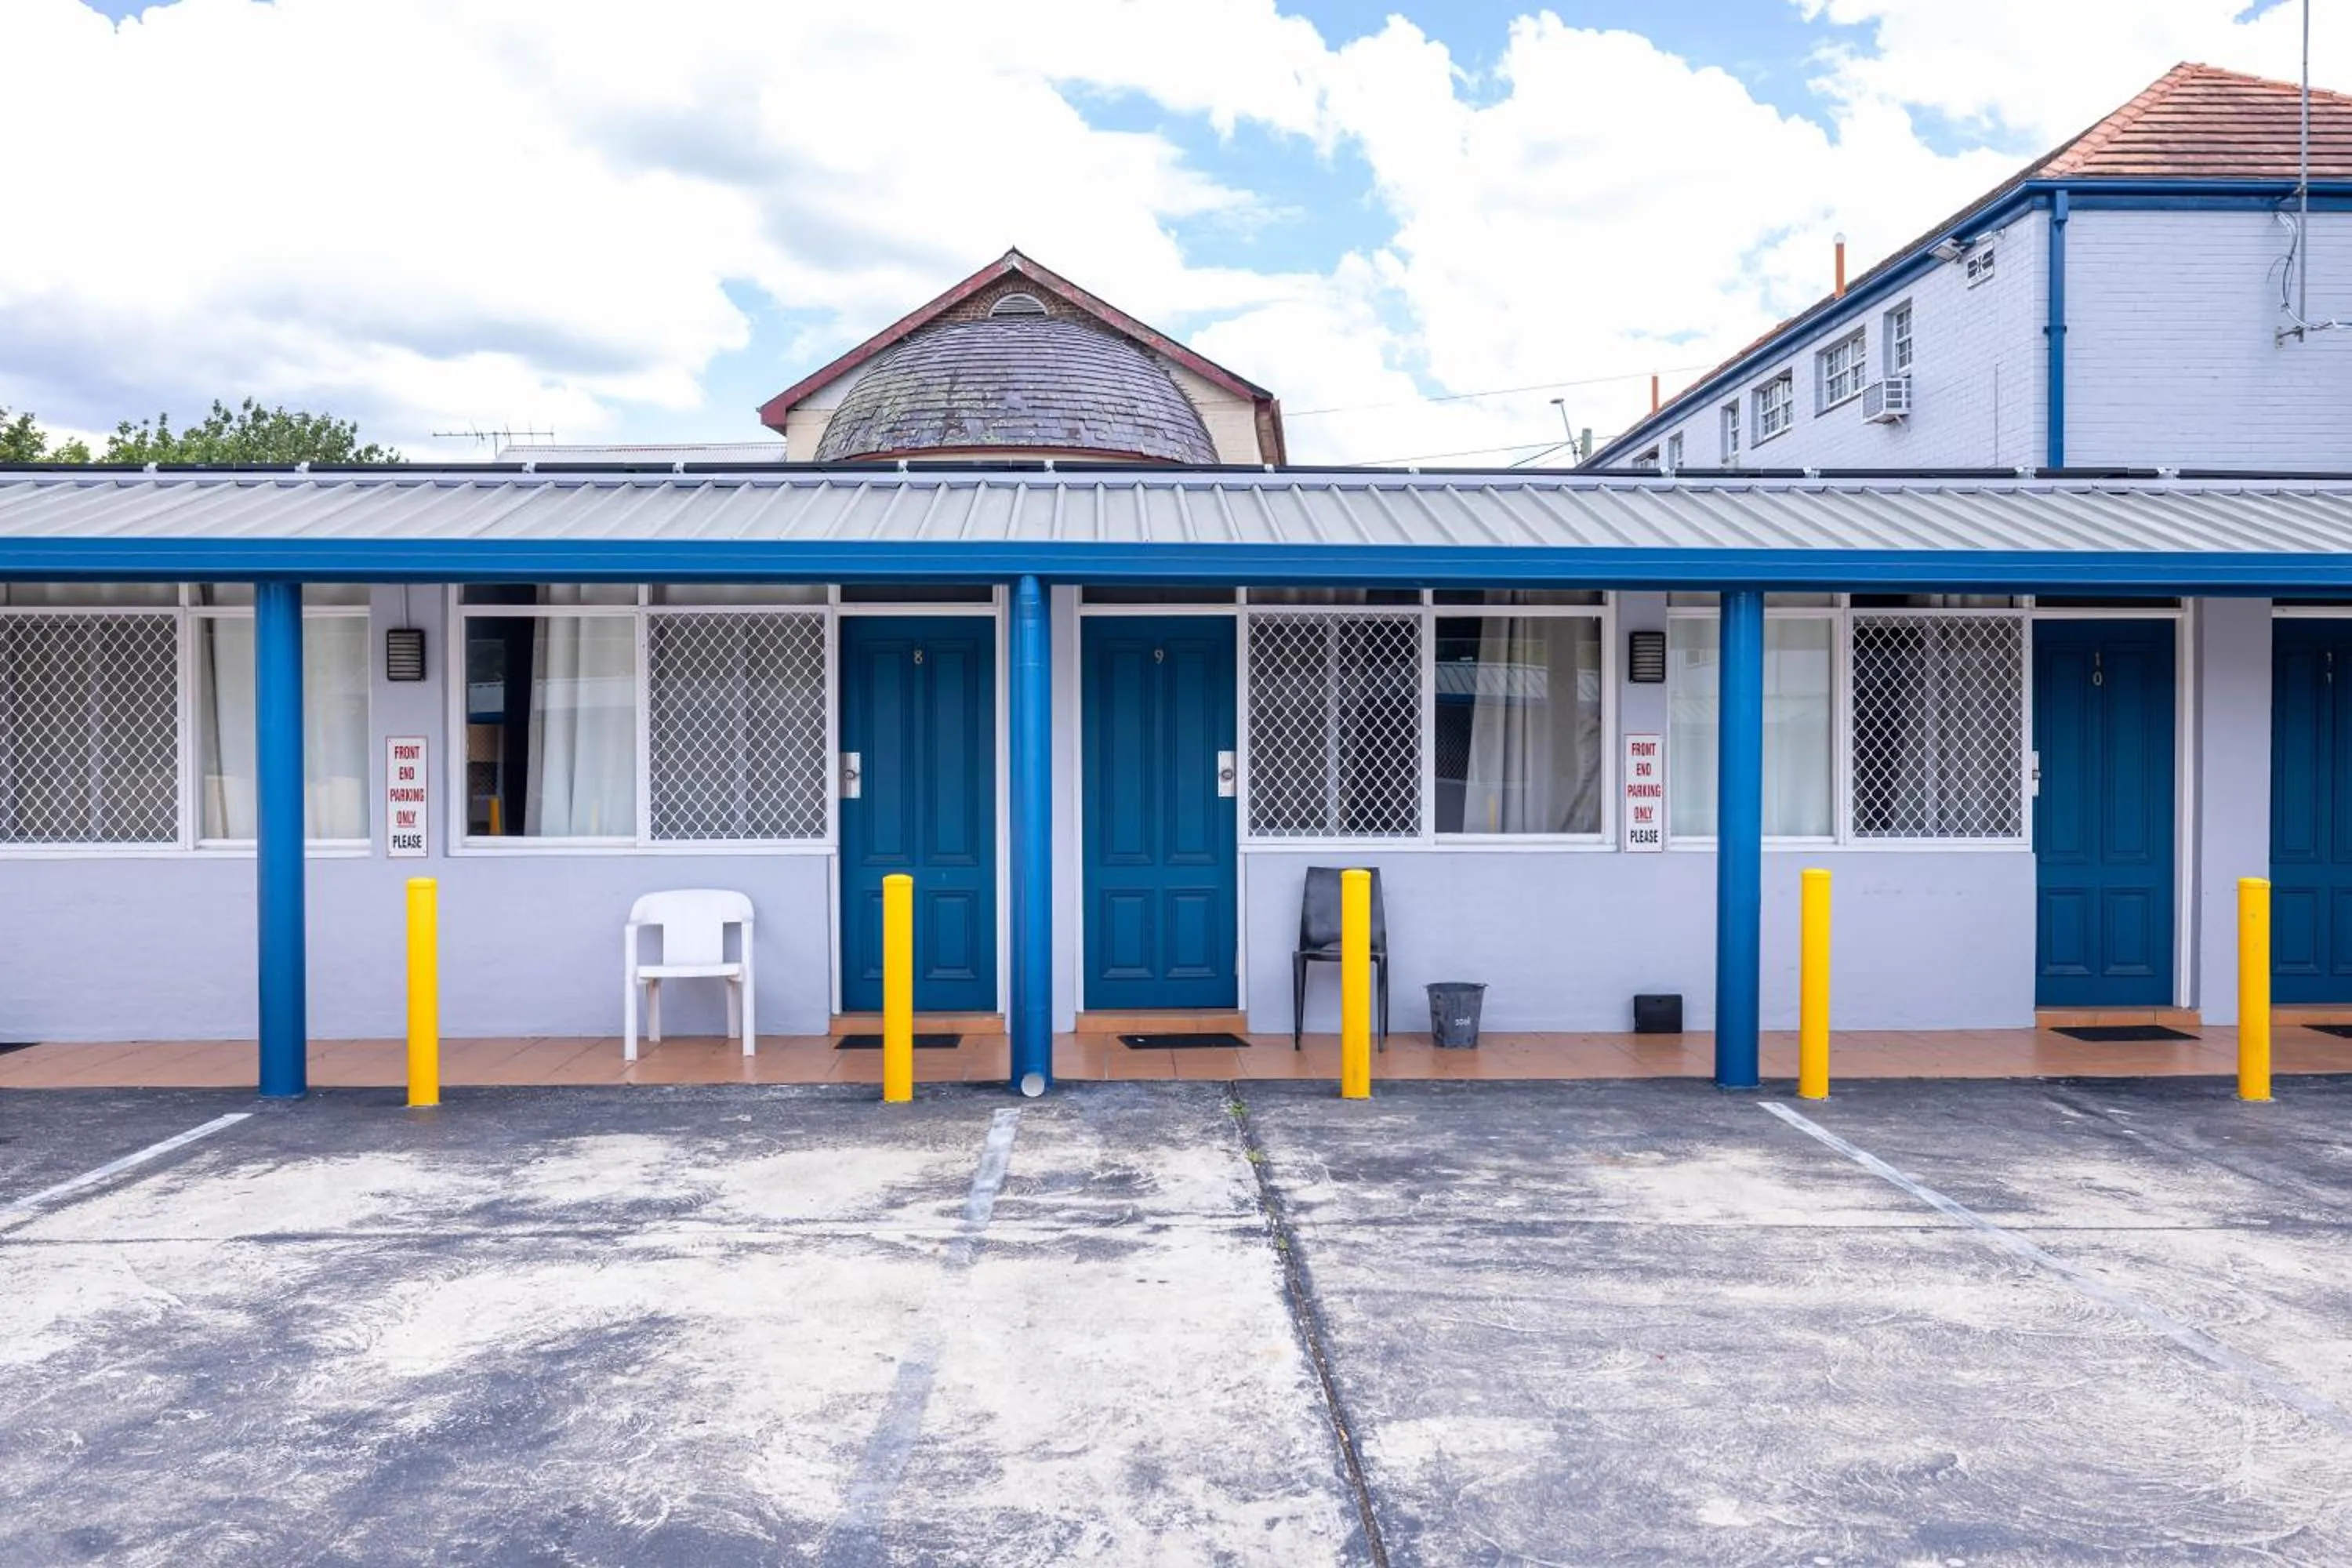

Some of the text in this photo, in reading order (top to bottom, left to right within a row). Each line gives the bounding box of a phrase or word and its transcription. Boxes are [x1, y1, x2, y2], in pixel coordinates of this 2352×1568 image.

[914, 650, 923, 664] 8
[1154, 649, 1164, 664] 9
[394, 746, 420, 759] FRONT
[1632, 742, 1656, 757] FRONT
[399, 766, 415, 780] END
[1636, 762, 1652, 776] END
[390, 788, 424, 801] PARKING
[1628, 784, 1661, 797] PARKING
[397, 810, 416, 824] ONLY
[1634, 806, 1653, 819] ONLY
[393, 835, 422, 848] PLEASE
[1631, 829, 1658, 843] PLEASE
